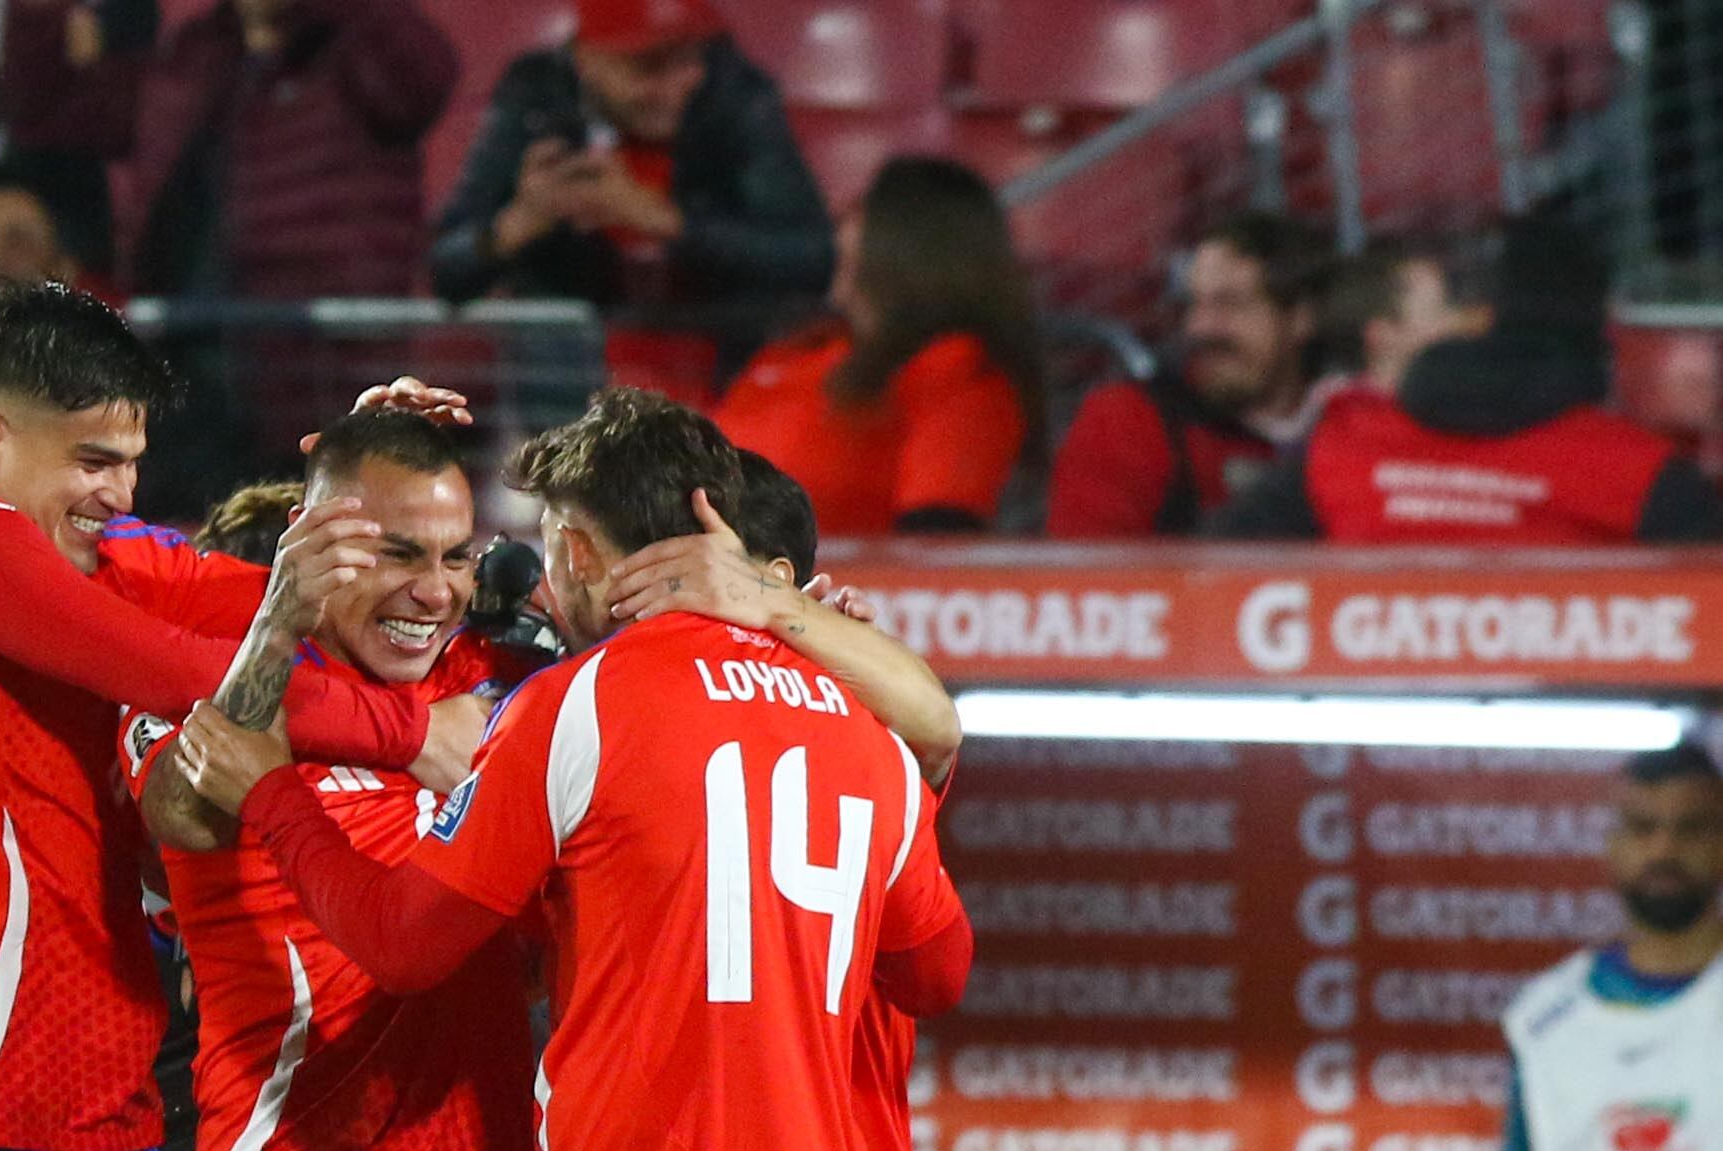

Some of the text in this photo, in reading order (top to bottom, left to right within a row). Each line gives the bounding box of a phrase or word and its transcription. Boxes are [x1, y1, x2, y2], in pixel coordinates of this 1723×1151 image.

[1238, 580, 1694, 672] G GATORADE
[694, 658, 849, 717] LOYOLA
[1365, 804, 1621, 856] GATORAD
[704, 740, 874, 1016] 14
[1295, 1039, 1357, 1114] G
